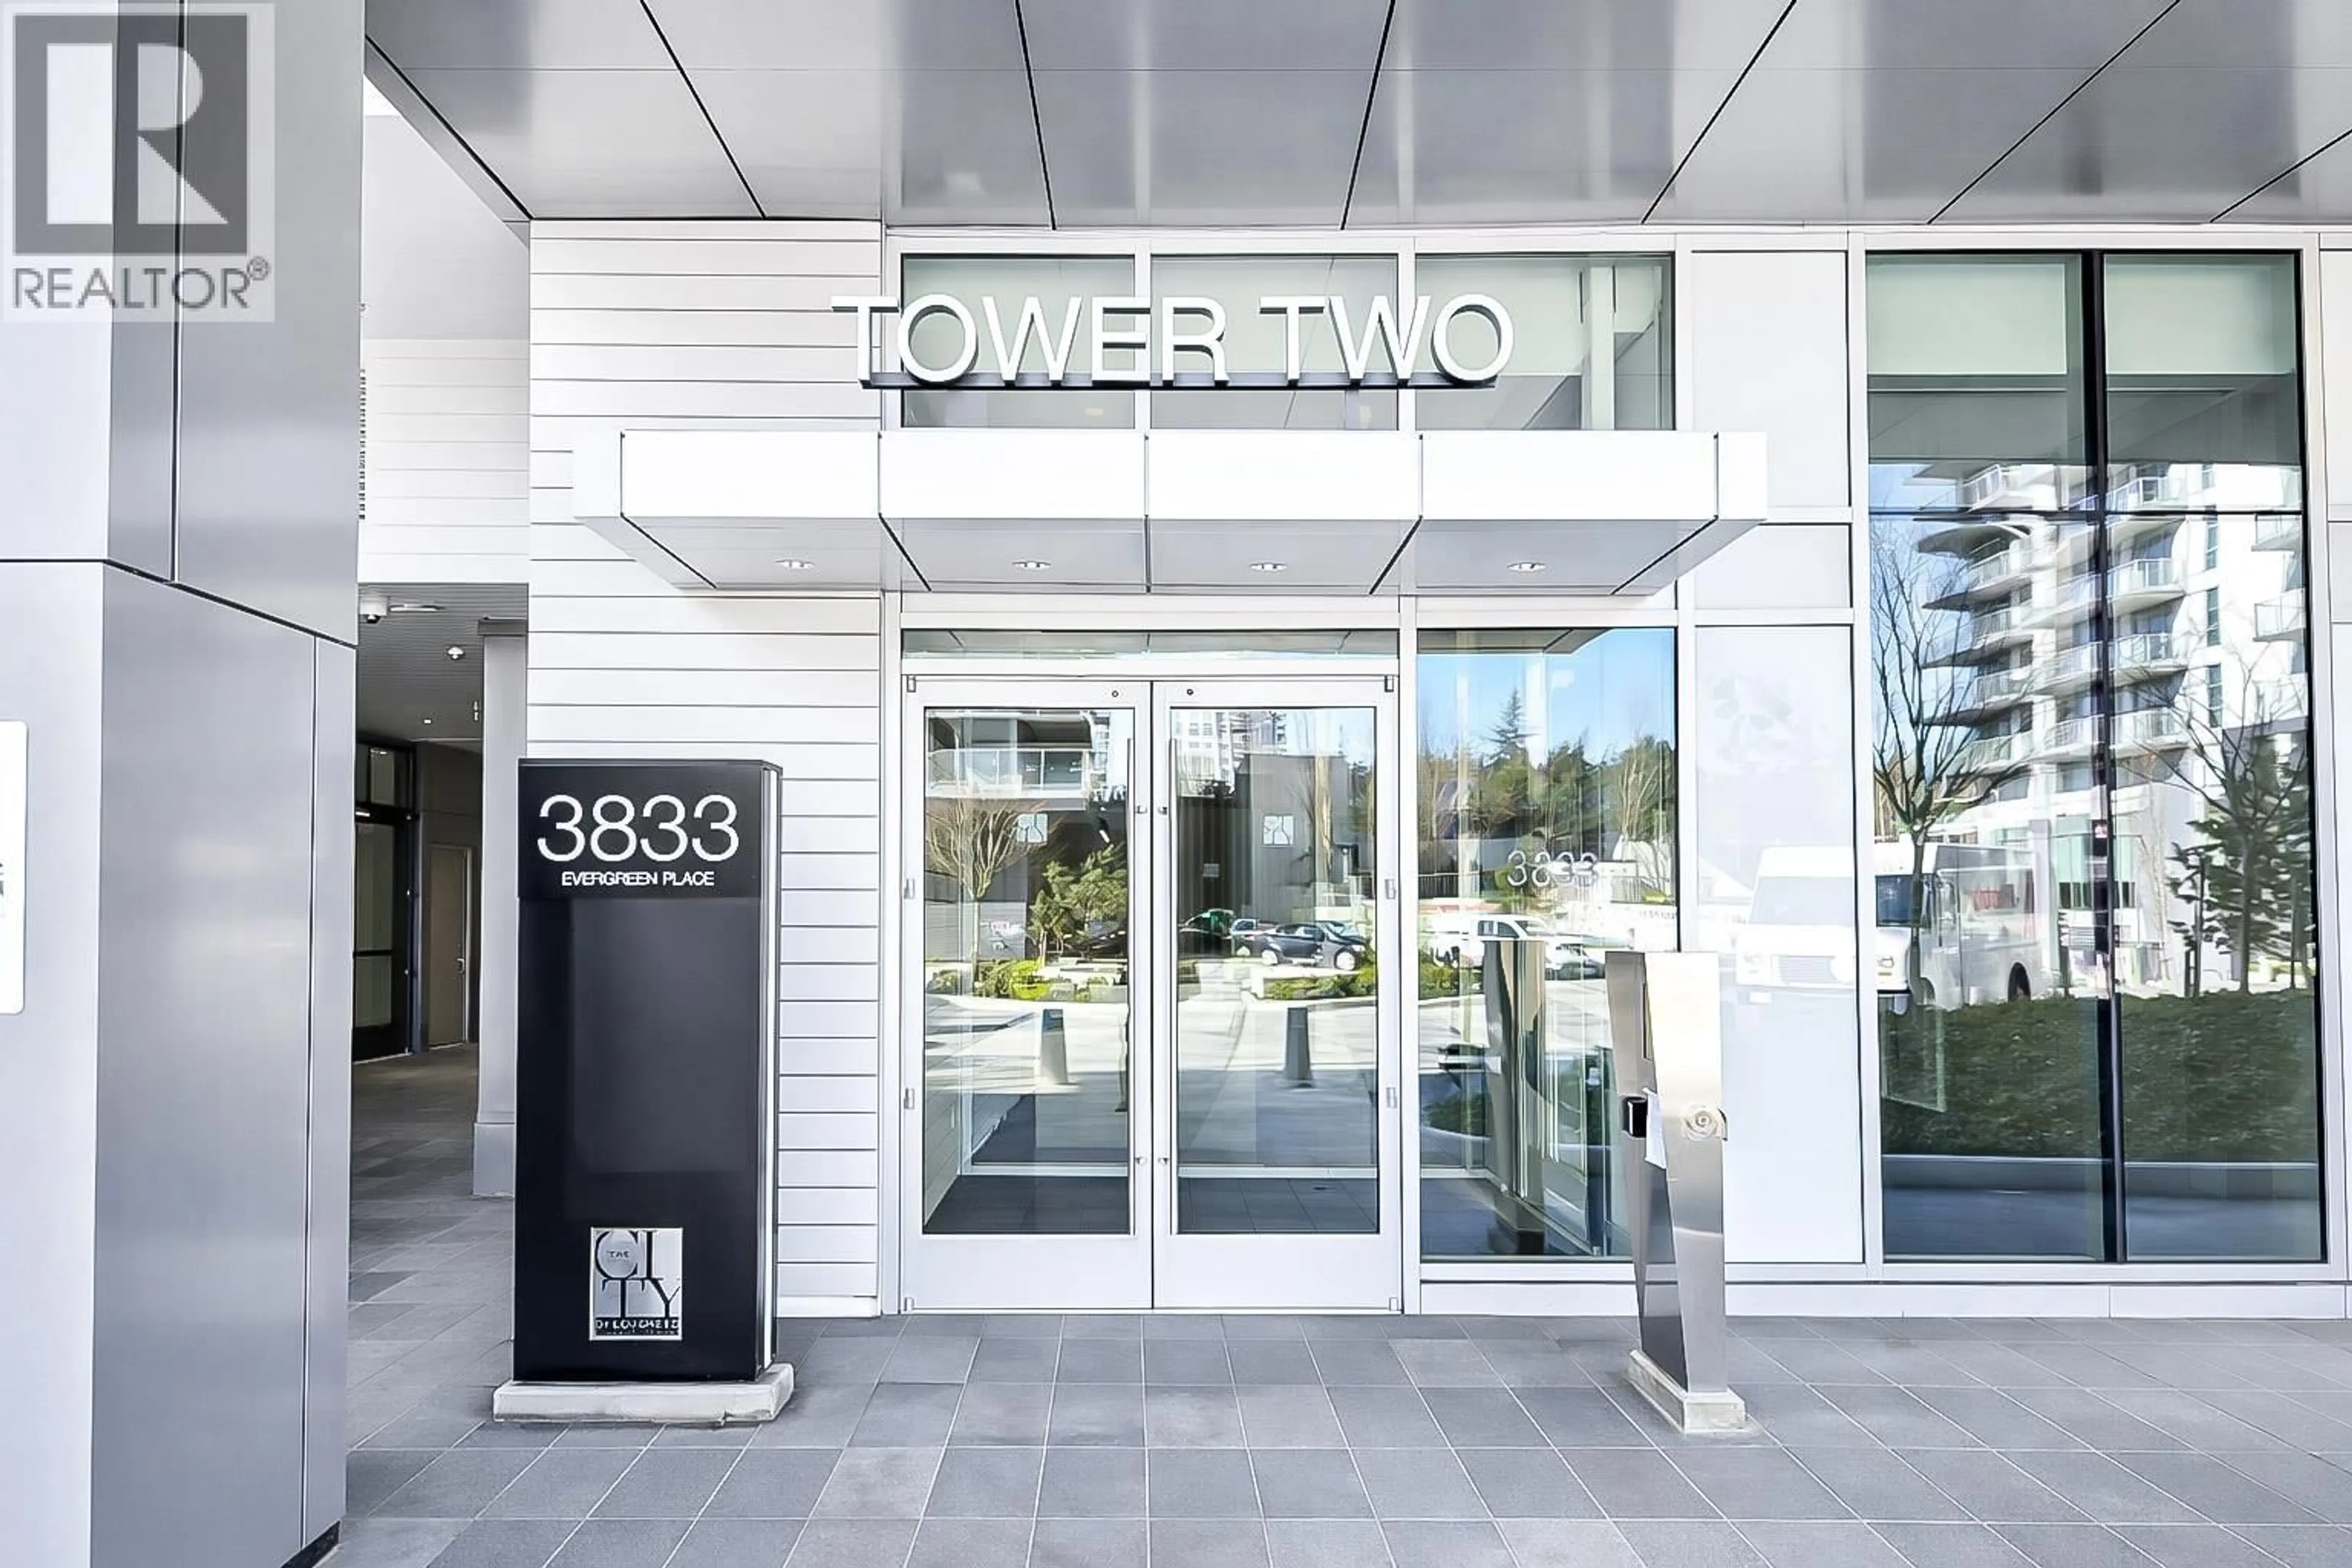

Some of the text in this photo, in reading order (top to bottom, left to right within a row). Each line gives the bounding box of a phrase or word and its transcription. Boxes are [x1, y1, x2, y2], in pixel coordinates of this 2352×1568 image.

[831, 293, 1515, 388] TOWER TWO
[537, 794, 740, 862] 3833
[561, 871, 715, 886] EVERGREEN PLACE
